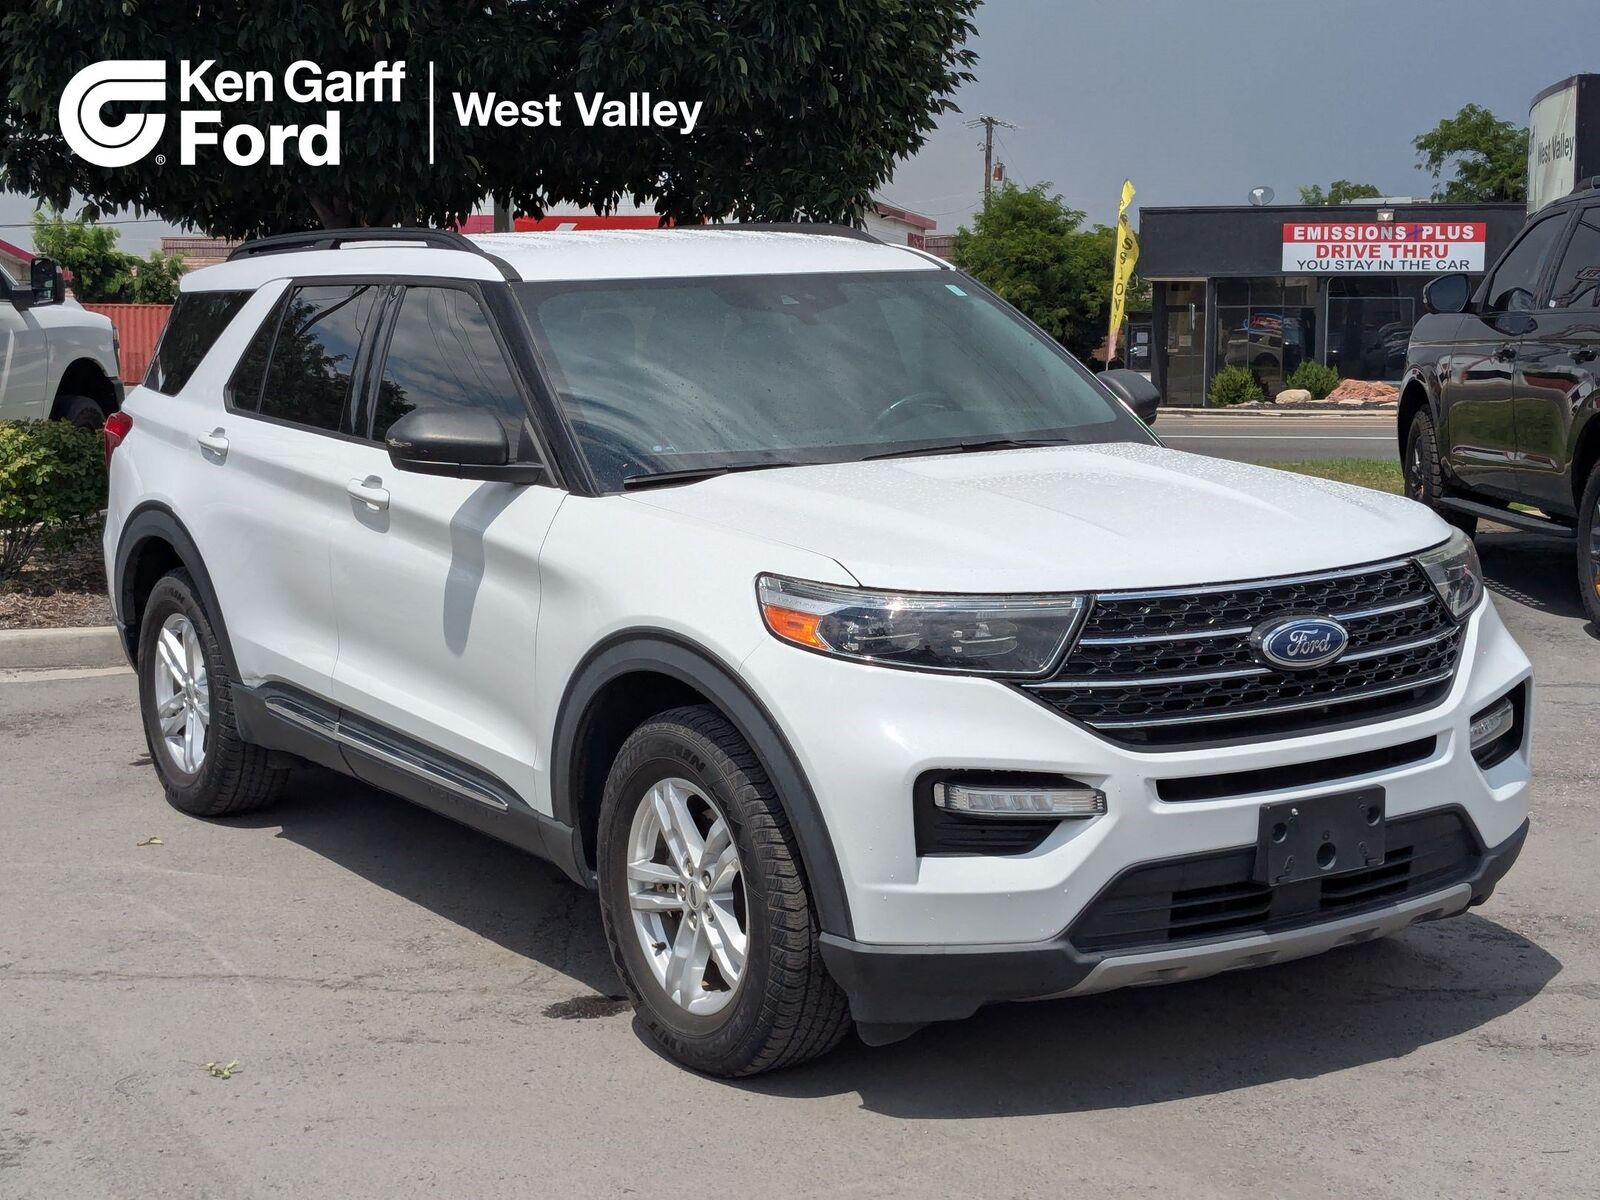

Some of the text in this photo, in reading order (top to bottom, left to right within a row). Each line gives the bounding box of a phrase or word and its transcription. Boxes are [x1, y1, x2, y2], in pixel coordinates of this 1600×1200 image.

[1551, 132, 1575, 161] Valley
[1293, 225, 1475, 241] EMISSIONS PLUS
[1316, 244, 1449, 259] DRIVE THRU
[1297, 259, 1470, 271] YOU STAY IN THE CAR
[1286, 628, 1332, 657] Ford
